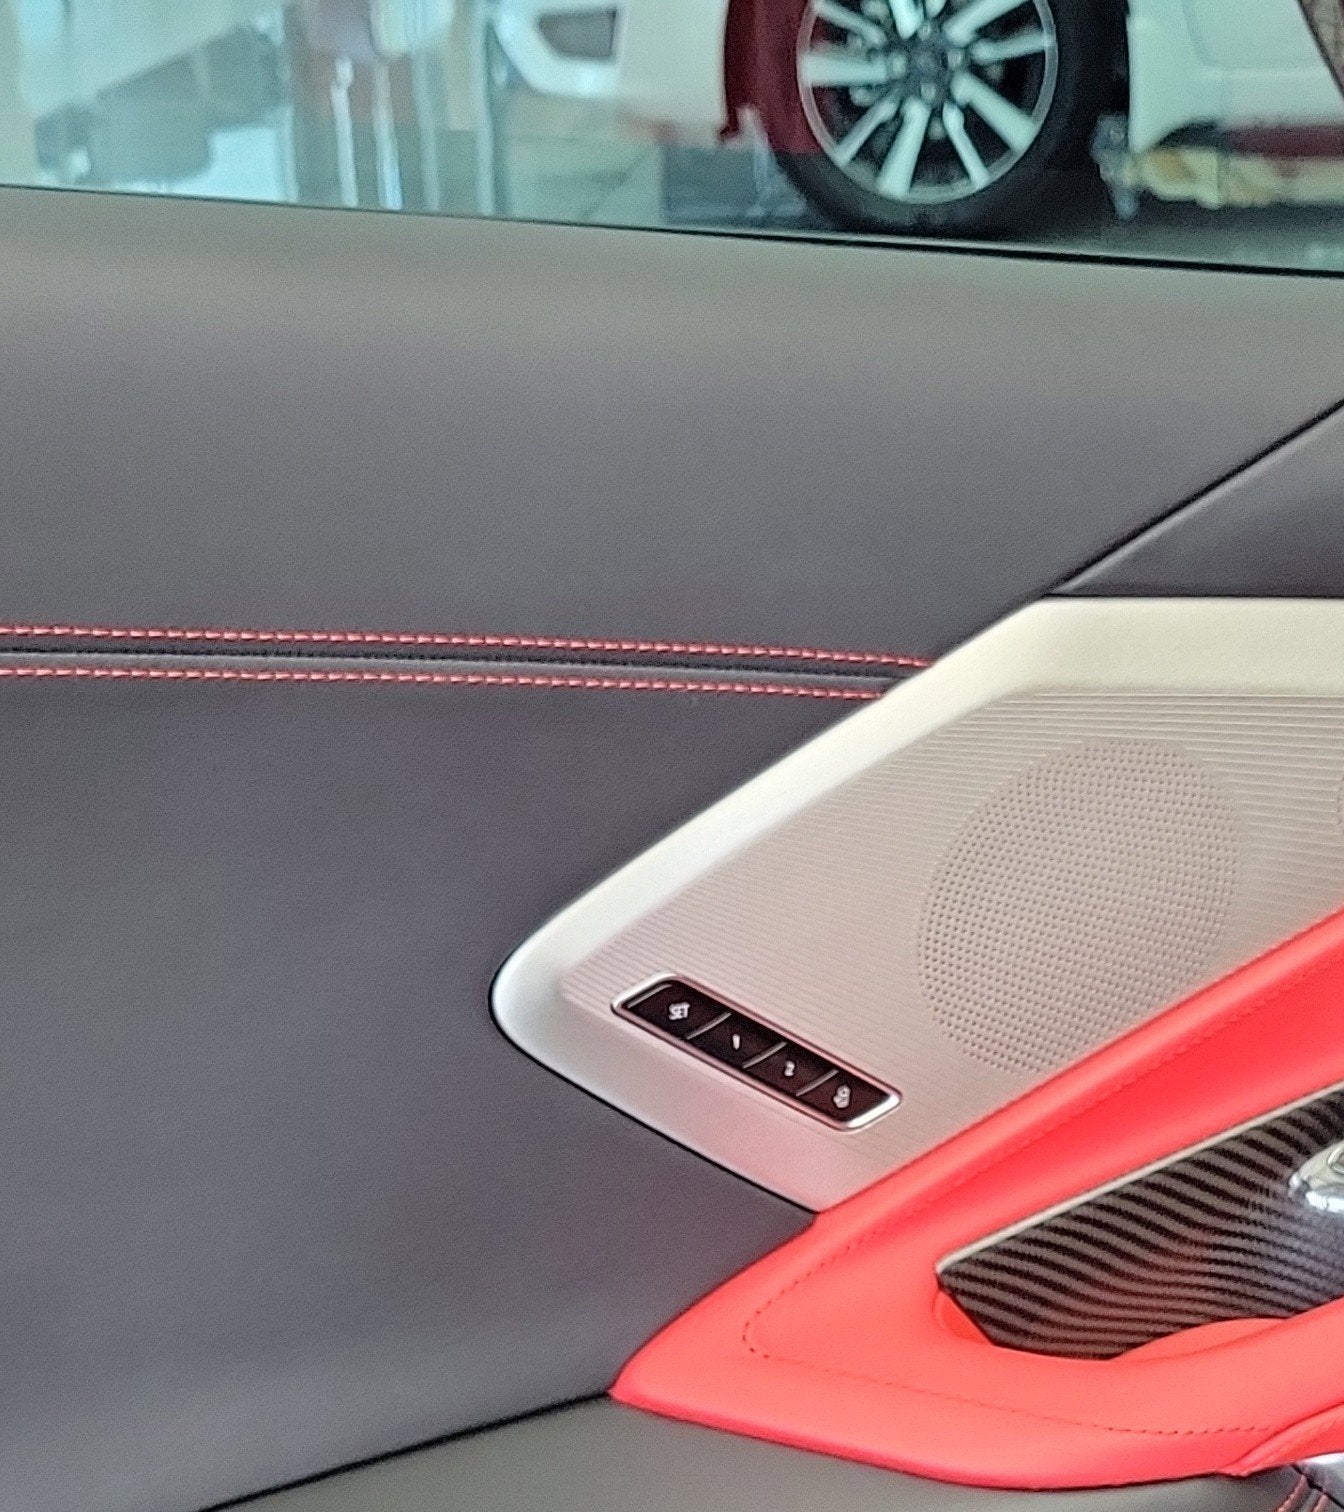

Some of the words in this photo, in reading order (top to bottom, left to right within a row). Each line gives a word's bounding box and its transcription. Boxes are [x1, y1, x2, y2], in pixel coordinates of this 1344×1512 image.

[668, 1001, 691, 1021] SET
[732, 1033, 741, 1051] 1
[784, 1060, 795, 1077] 2
